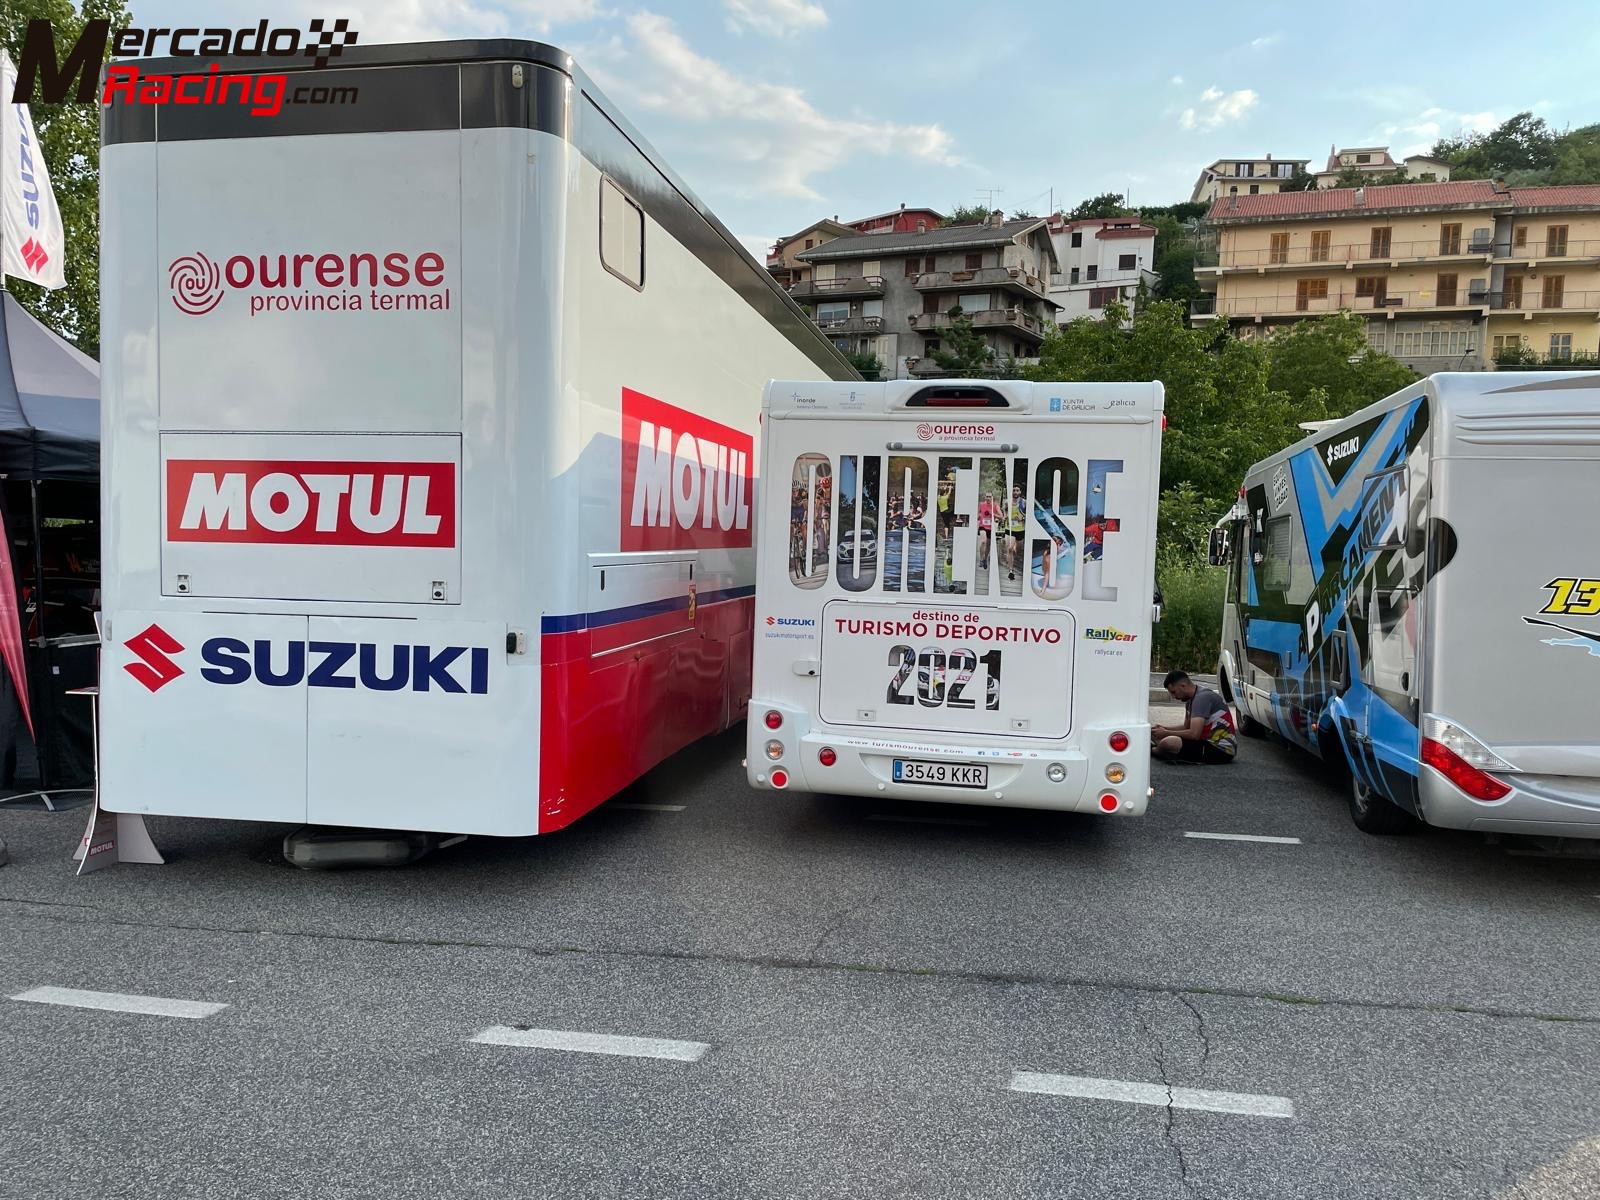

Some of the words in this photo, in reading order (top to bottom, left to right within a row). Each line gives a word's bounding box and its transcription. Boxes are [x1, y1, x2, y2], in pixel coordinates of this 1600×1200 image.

[225, 251, 445, 289] ourense
[250, 289, 362, 316] provincia
[370, 288, 450, 311] termal
[934, 424, 994, 435] ourense
[1333, 436, 1360, 461] SUZUKI
[630, 420, 749, 532] MOTUL
[179, 472, 442, 534] MOTUL
[789, 452, 1124, 601] OURENSE
[1536, 576, 1600, 617] 13
[777, 618, 815, 626] SUZUKI
[912, 610, 960, 622] destino
[963, 612, 980, 623] de
[835, 619, 928, 637] TURISMO
[935, 624, 1061, 644] DEPORTIVO
[200, 637, 489, 695] SUZUKI
[886, 644, 1002, 711] 2021
[905, 764, 946, 781] 3549
[951, 769, 982, 784] KKR
[90, 842, 114, 856] MOTUL
